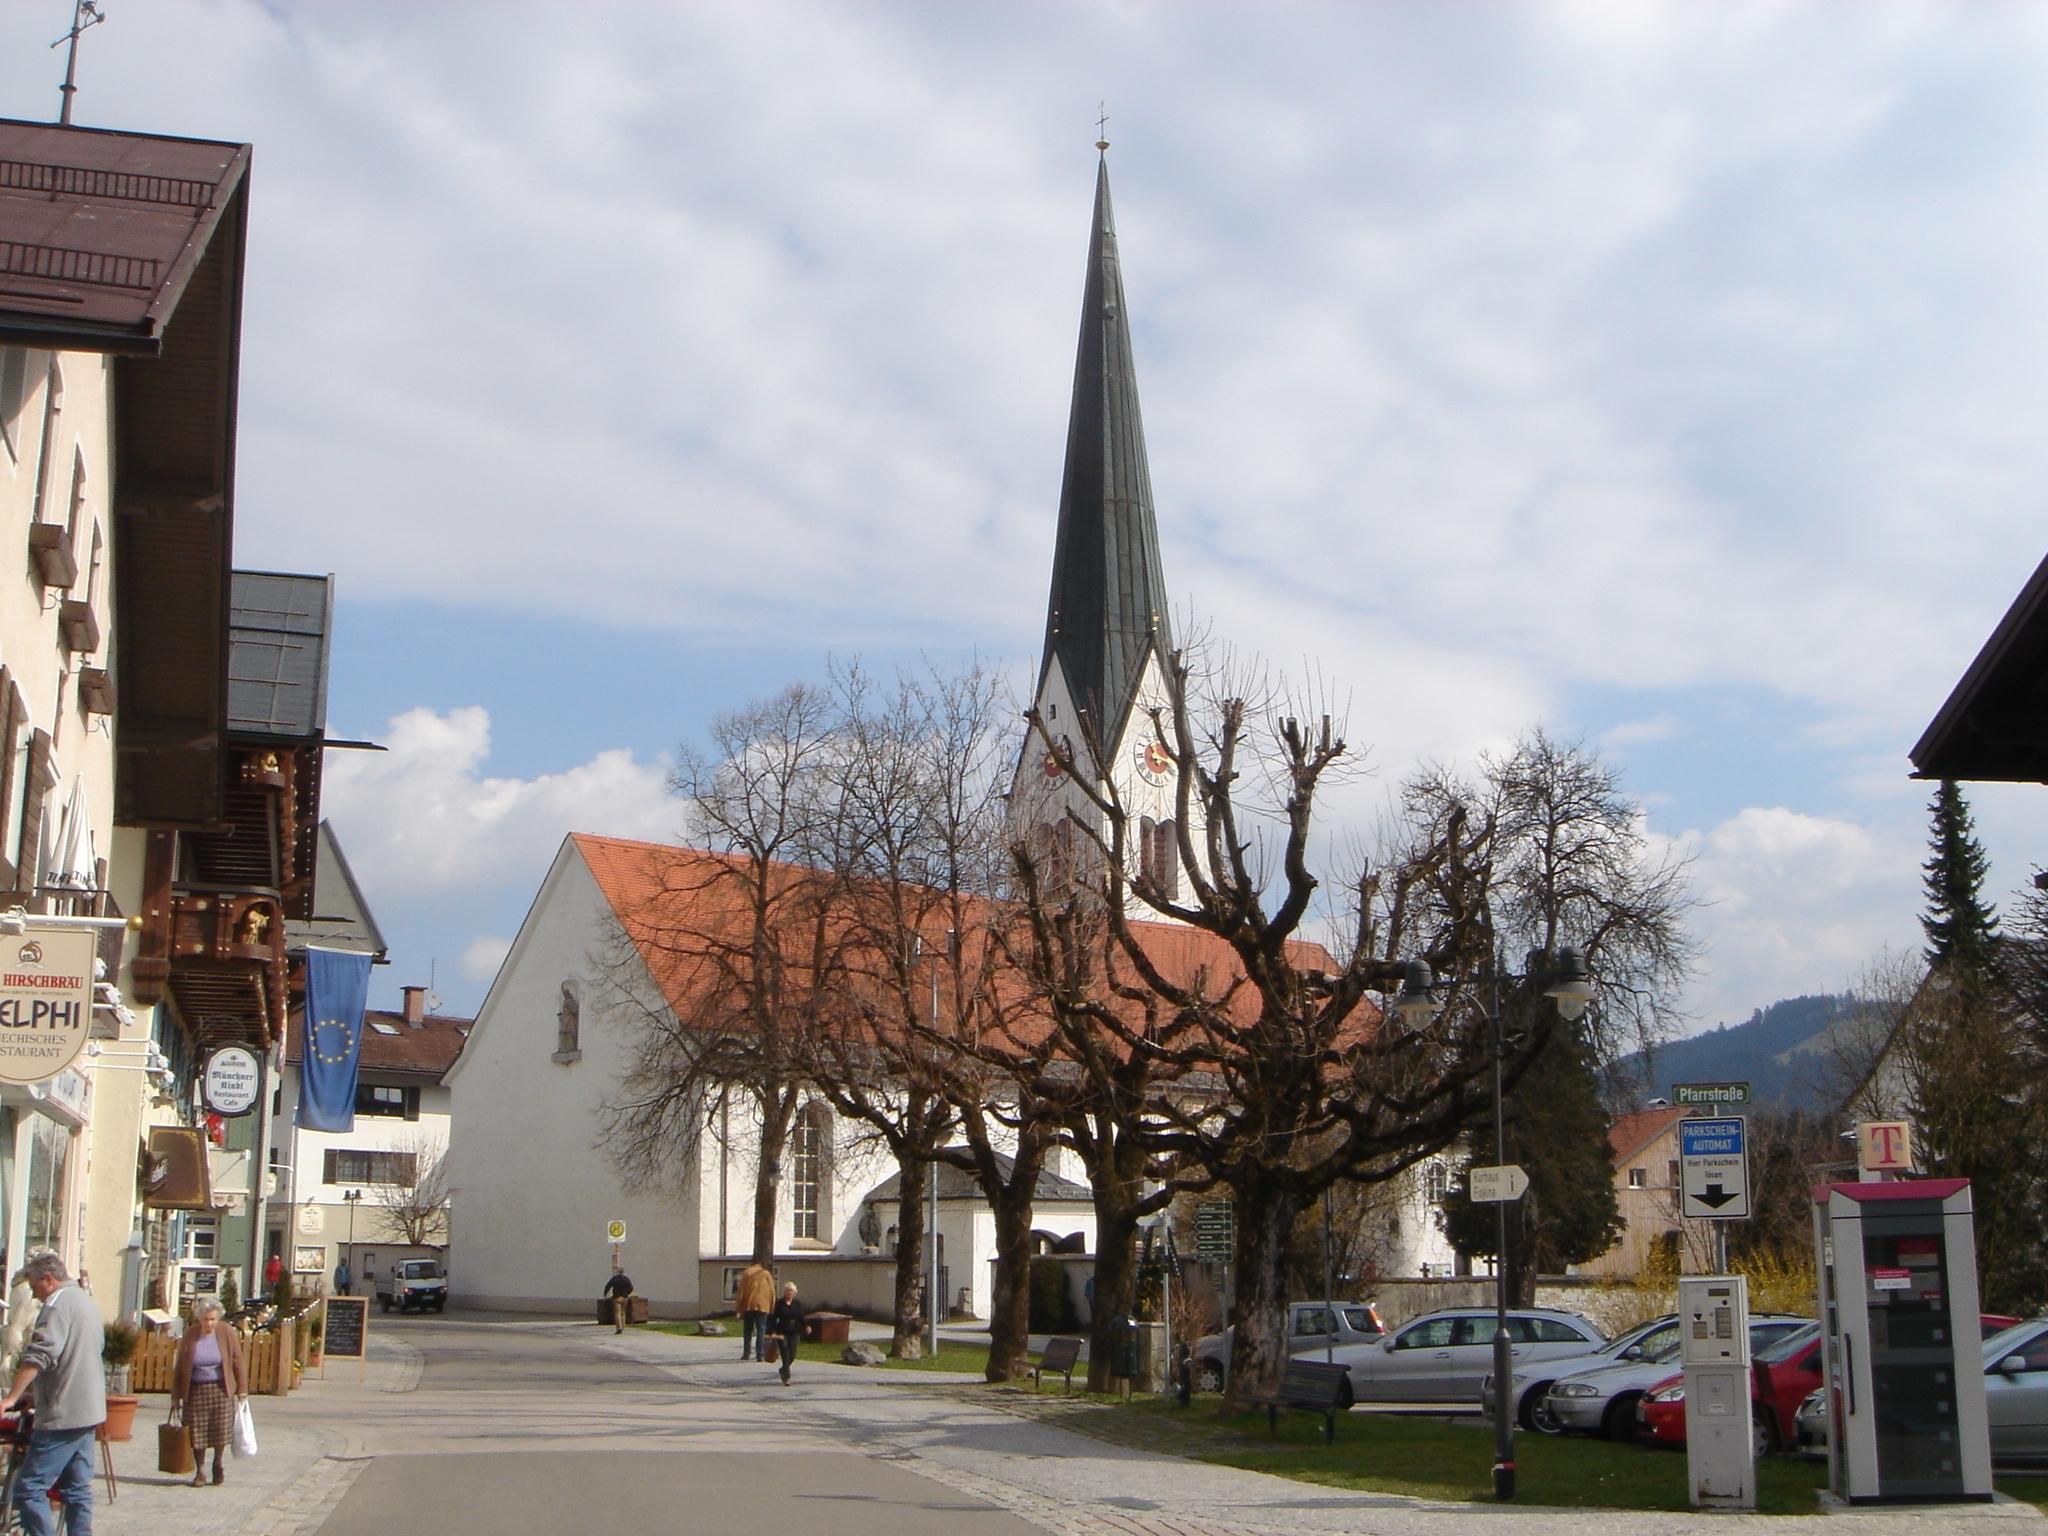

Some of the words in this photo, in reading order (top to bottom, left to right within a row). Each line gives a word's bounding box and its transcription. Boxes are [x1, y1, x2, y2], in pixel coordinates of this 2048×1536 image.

[3, 973, 83, 989] HIRSCHBRÄU
[1680, 1086, 1743, 1102] Pfarrstraße
[1684, 1125, 1740, 1137] PARKSCHEIN-
[1693, 1139, 1732, 1151] AUTOMAT
[1871, 1126, 1901, 1164] T
